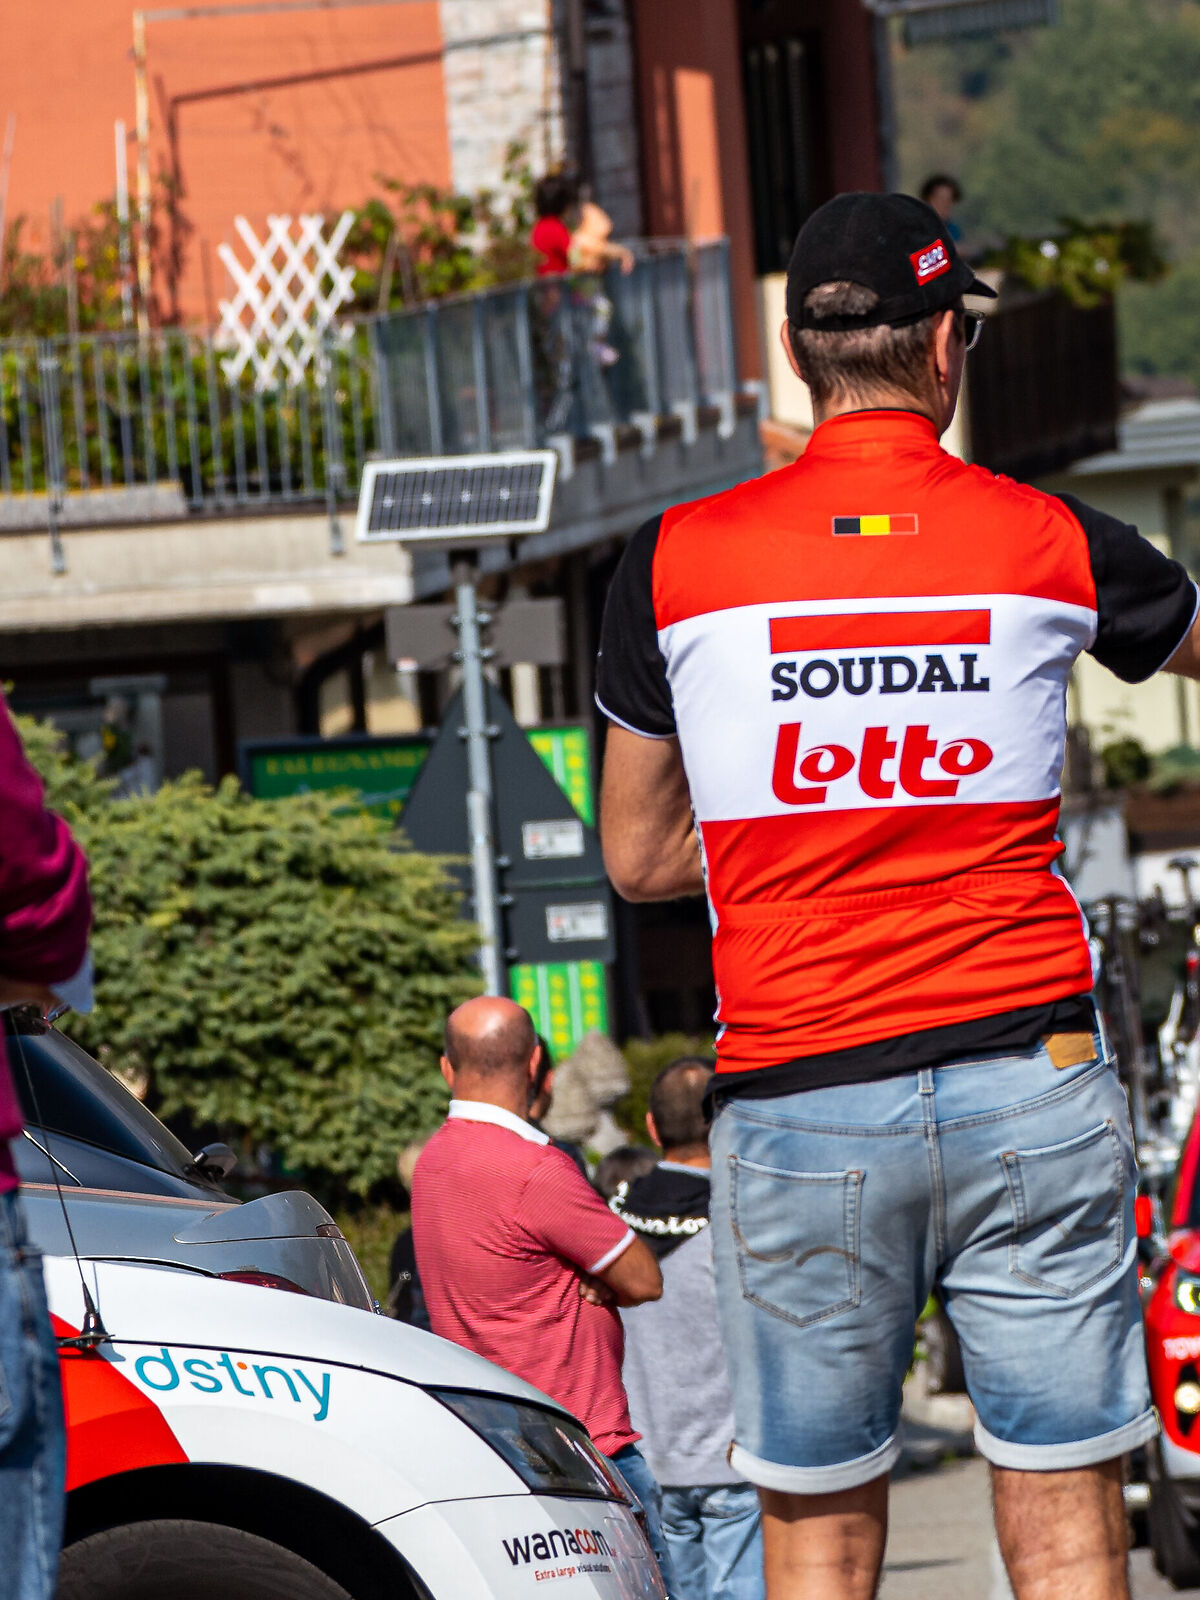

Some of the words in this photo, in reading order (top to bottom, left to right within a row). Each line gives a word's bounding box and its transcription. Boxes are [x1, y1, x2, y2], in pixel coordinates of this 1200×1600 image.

[770, 653, 991, 701] SOUDAL
[771, 721, 994, 806] lotto
[134, 1347, 332, 1421] dstny
[501, 1528, 612, 1566] wanacom
[535, 1570, 556, 1581] Extra
[556, 1566, 576, 1578] large
